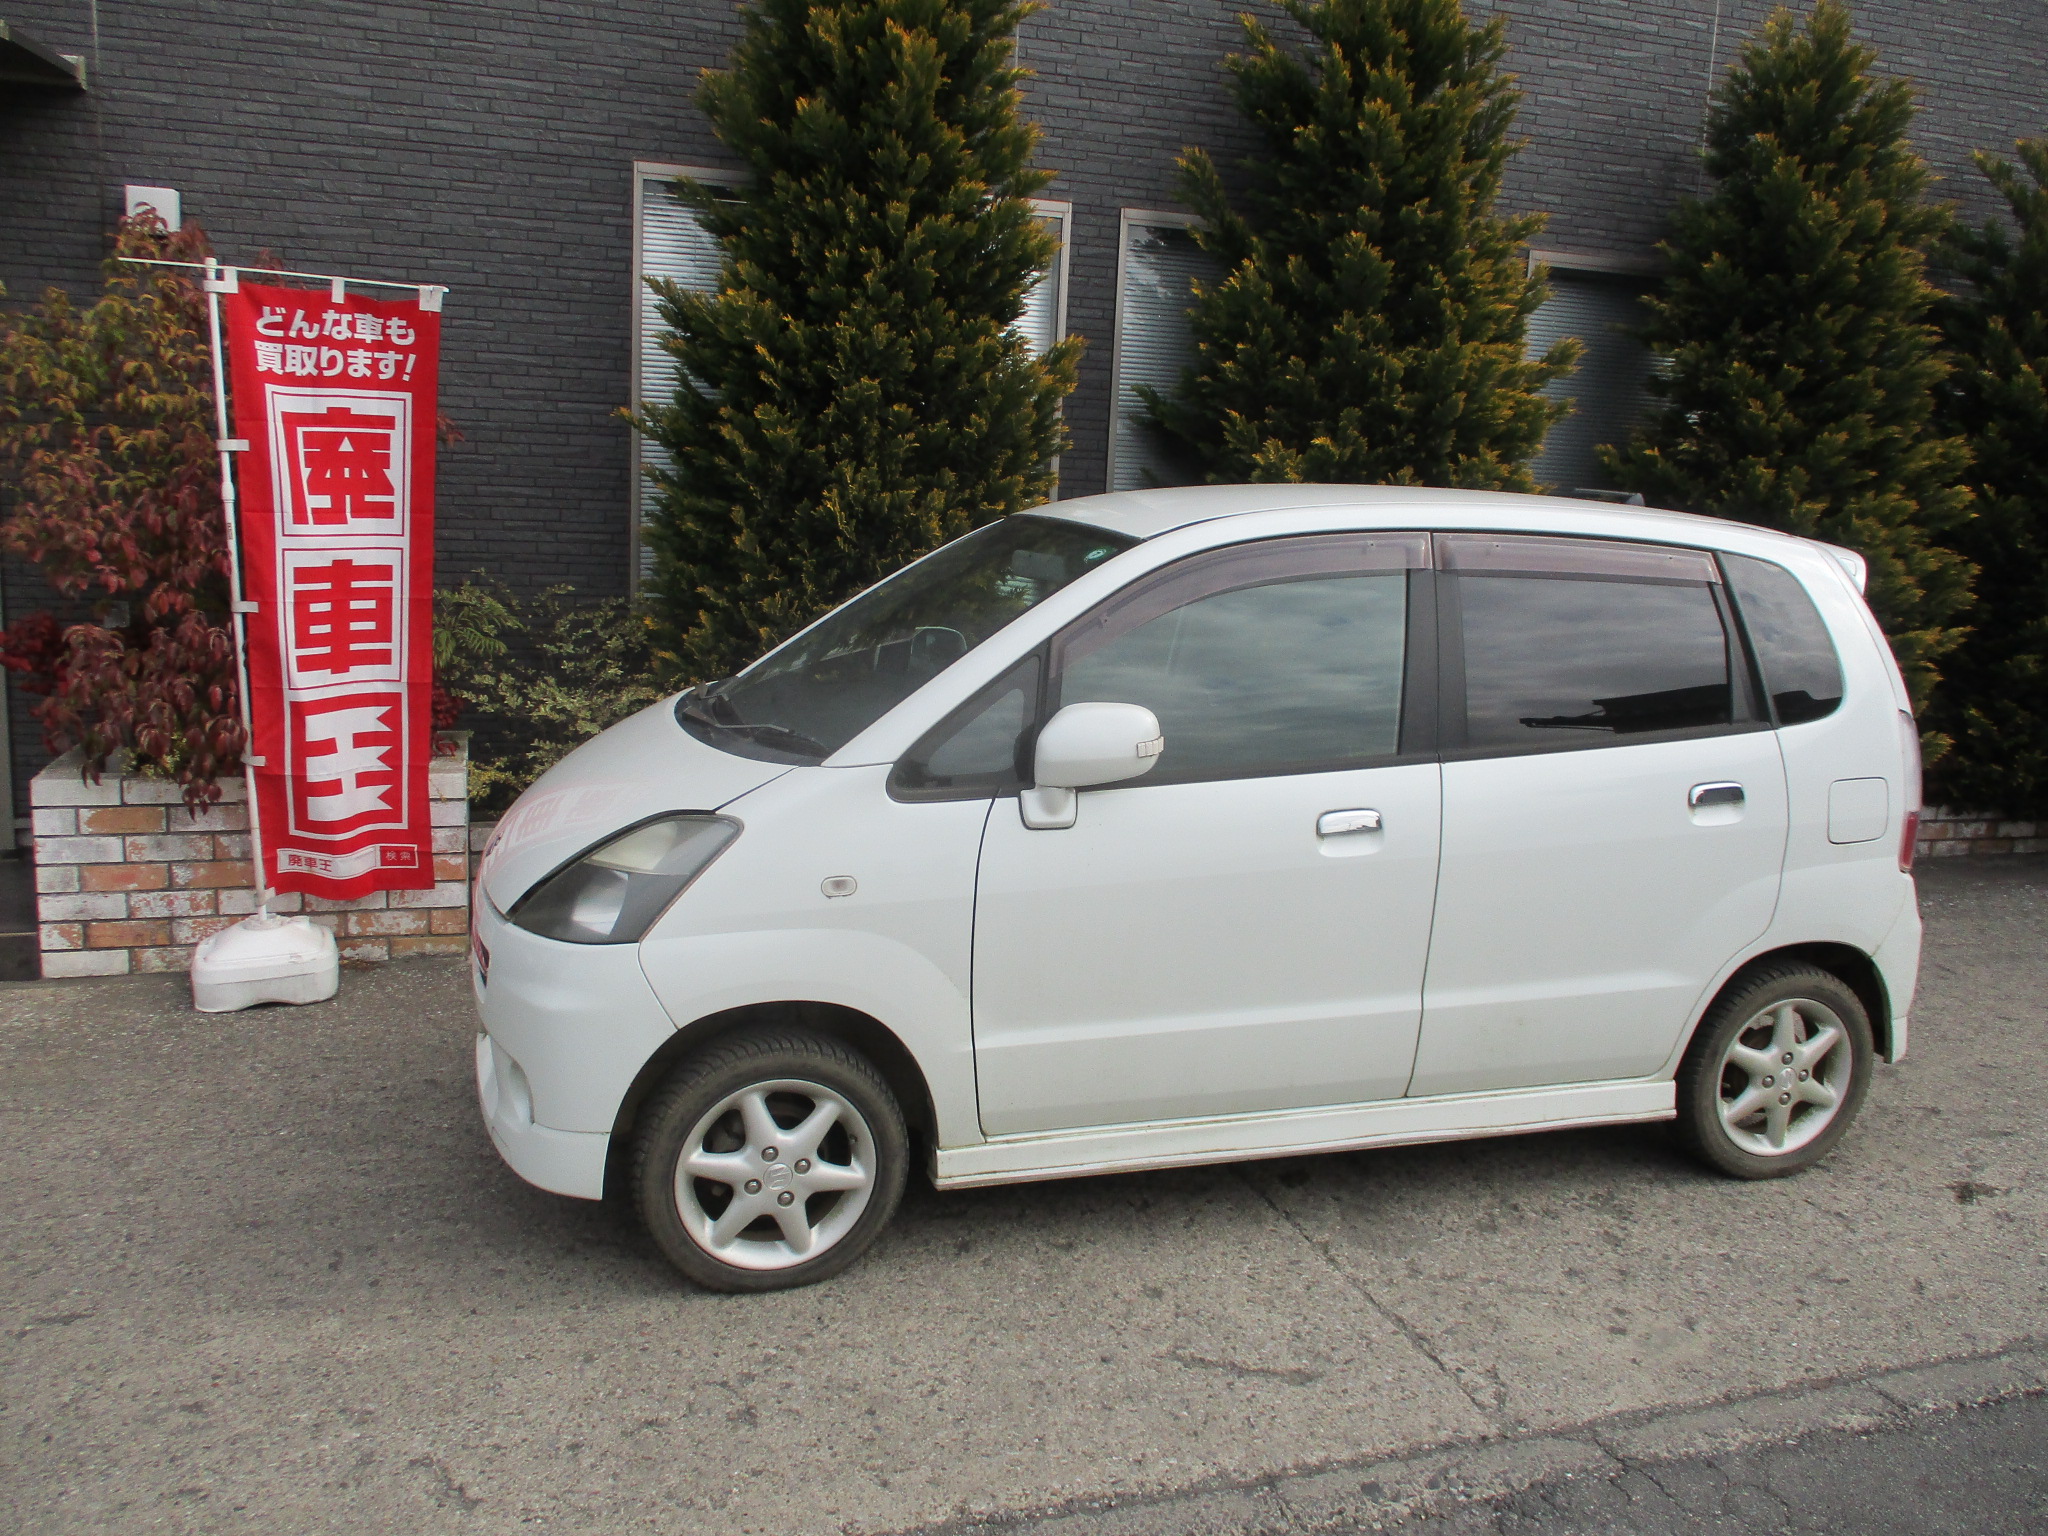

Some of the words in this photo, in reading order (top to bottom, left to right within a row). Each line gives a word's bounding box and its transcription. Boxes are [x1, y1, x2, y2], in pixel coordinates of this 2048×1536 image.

[255, 306, 416, 346] どんな車も
[254, 340, 416, 382] 買取ります!
[280, 406, 396, 822] 廃車王
[288, 854, 333, 873] 廃車王
